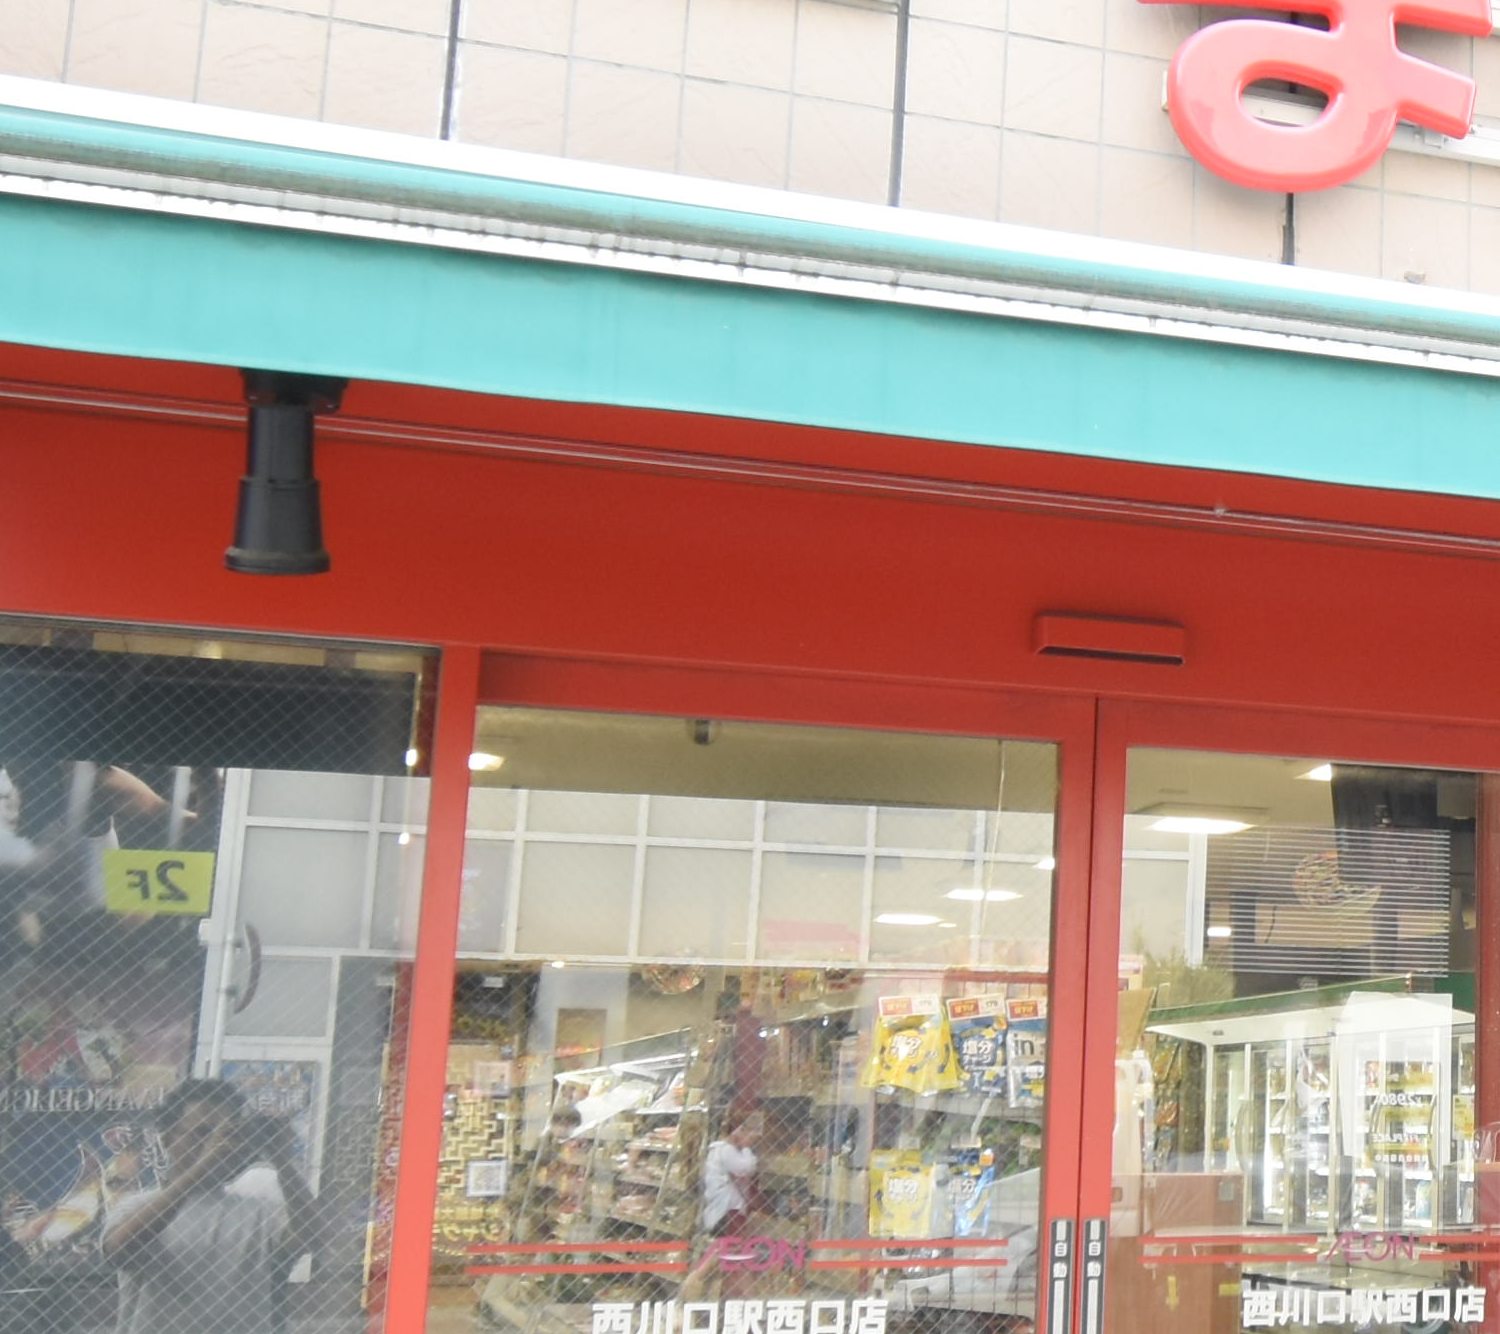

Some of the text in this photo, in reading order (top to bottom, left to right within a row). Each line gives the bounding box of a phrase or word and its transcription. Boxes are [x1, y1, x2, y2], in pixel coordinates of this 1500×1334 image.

[1242, 1286, 1487, 1328] 西川口駅西口店
